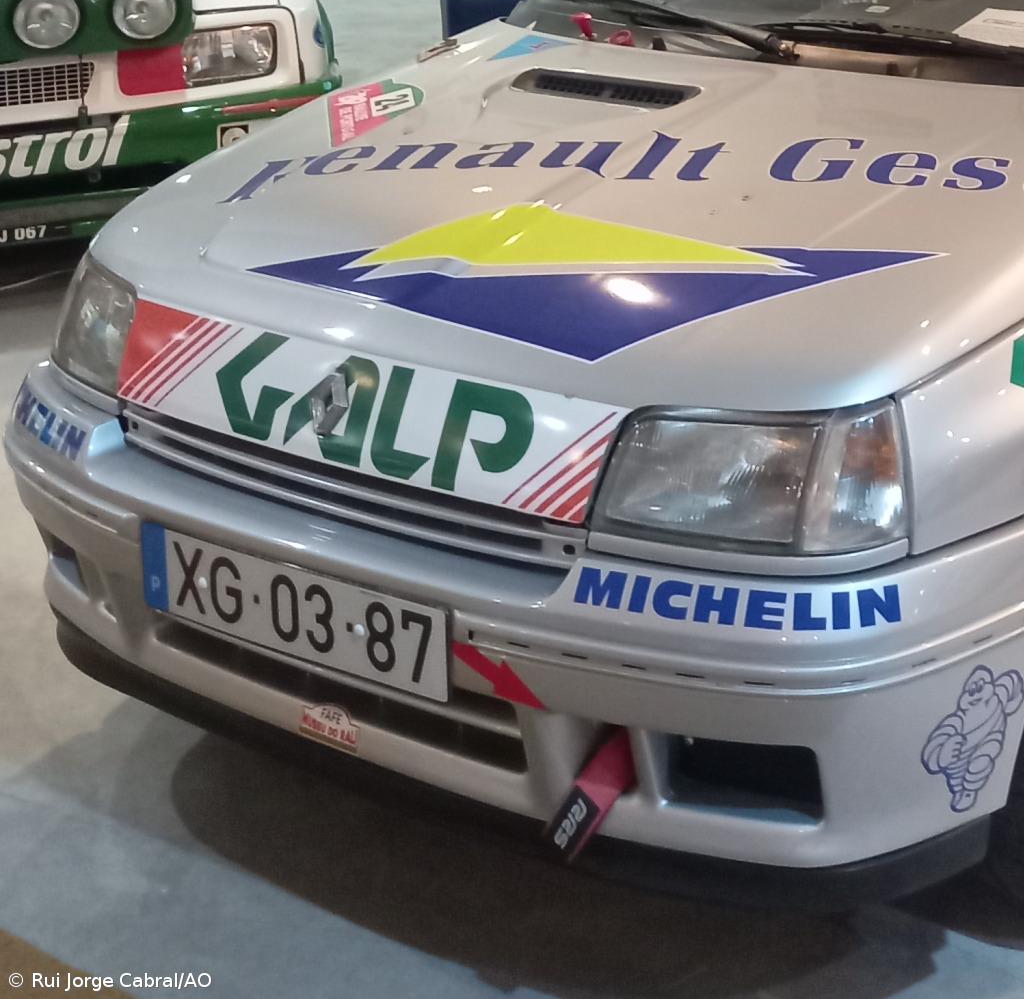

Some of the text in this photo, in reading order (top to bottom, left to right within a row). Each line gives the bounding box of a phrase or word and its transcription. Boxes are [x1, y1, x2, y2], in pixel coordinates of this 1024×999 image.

[0, 114, 131, 178] strol
[15, 225, 46, 240] 067
[216, 330, 535, 492] GALP
[574, 566, 901, 632] MICHELIN
